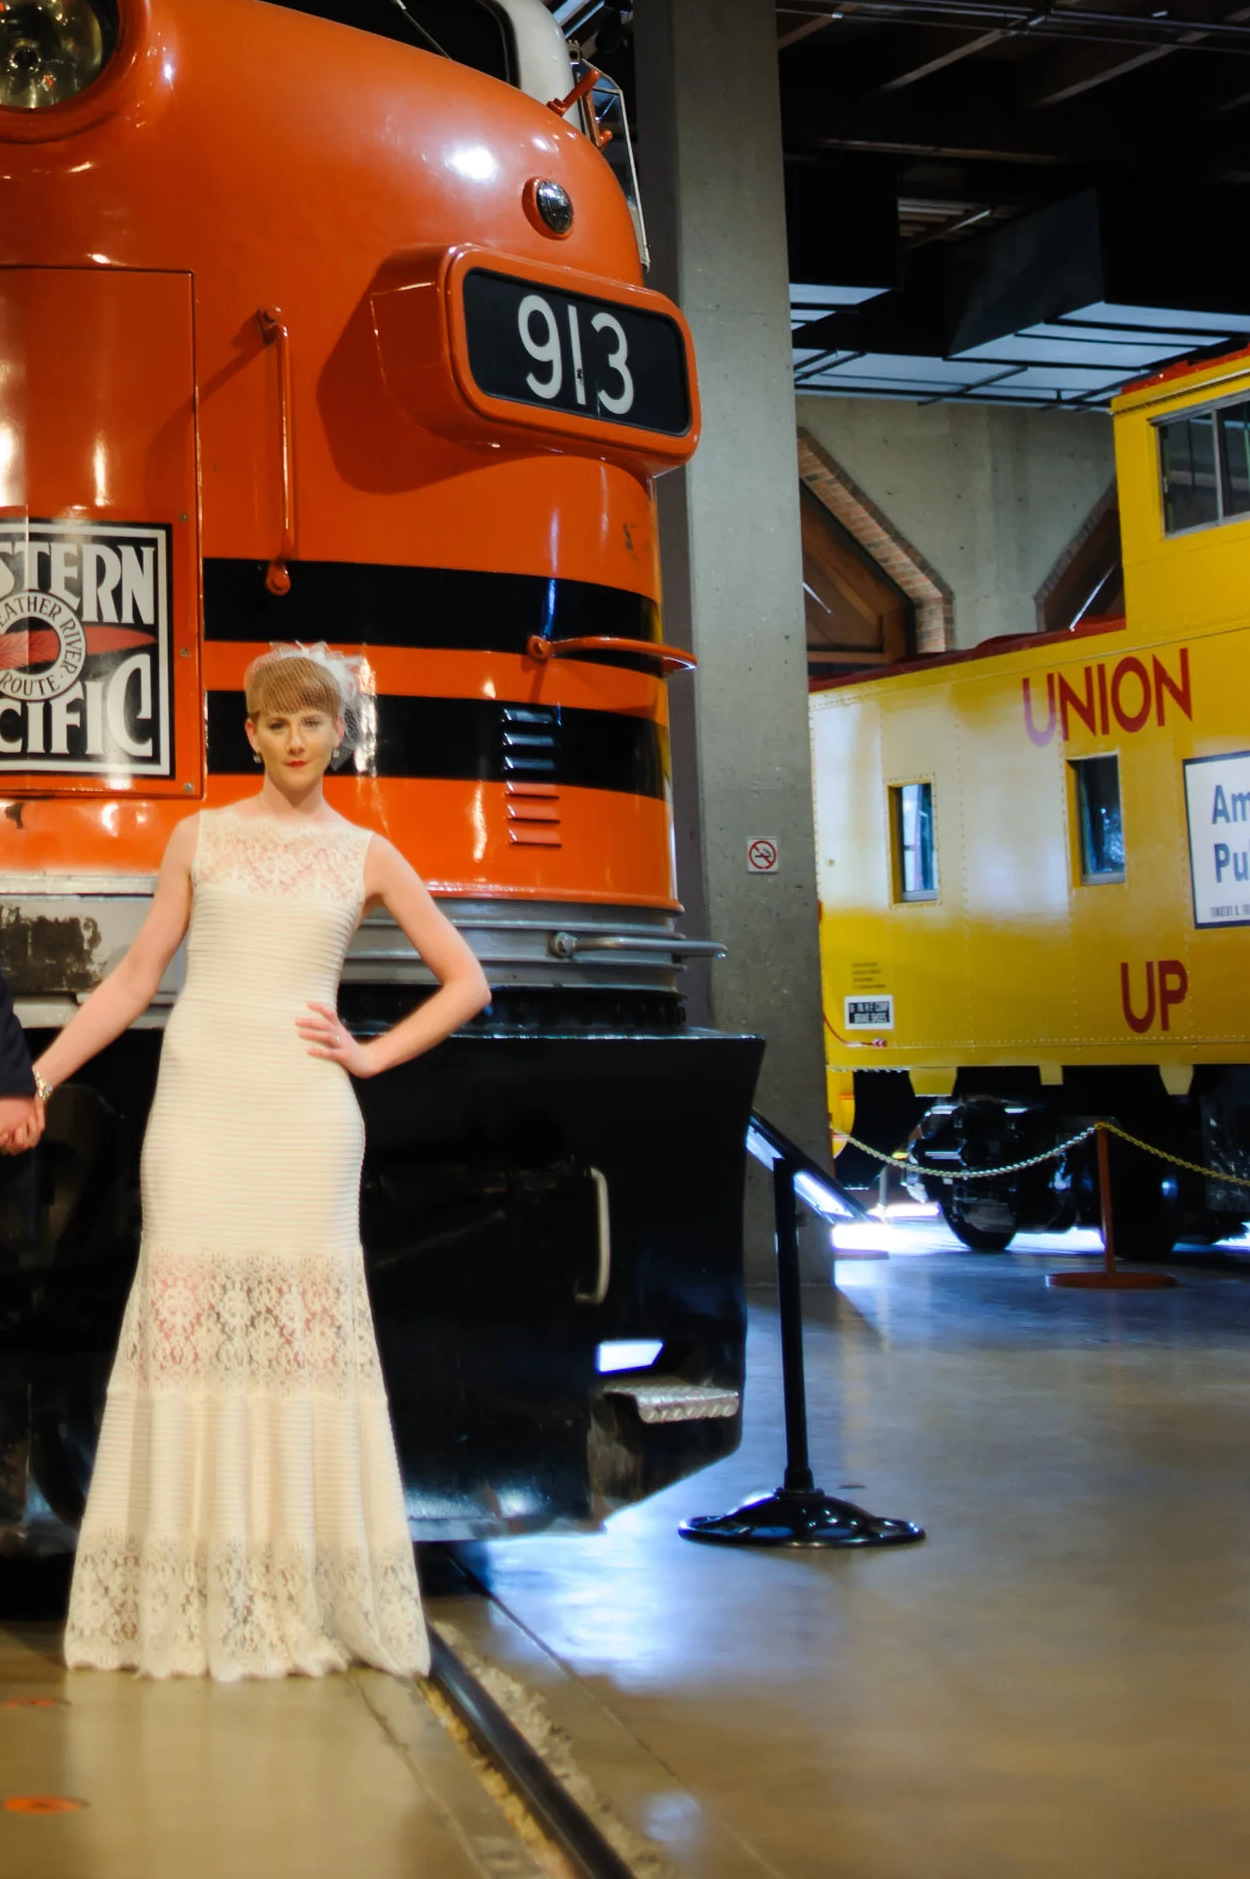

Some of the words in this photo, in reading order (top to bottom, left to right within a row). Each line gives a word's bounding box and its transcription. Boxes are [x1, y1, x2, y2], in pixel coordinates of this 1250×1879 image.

[518, 295, 634, 414] 913
[60, 618, 83, 674] RIVER
[1022, 648, 1193, 747] UNION
[1121, 959, 1188, 1033] UP
